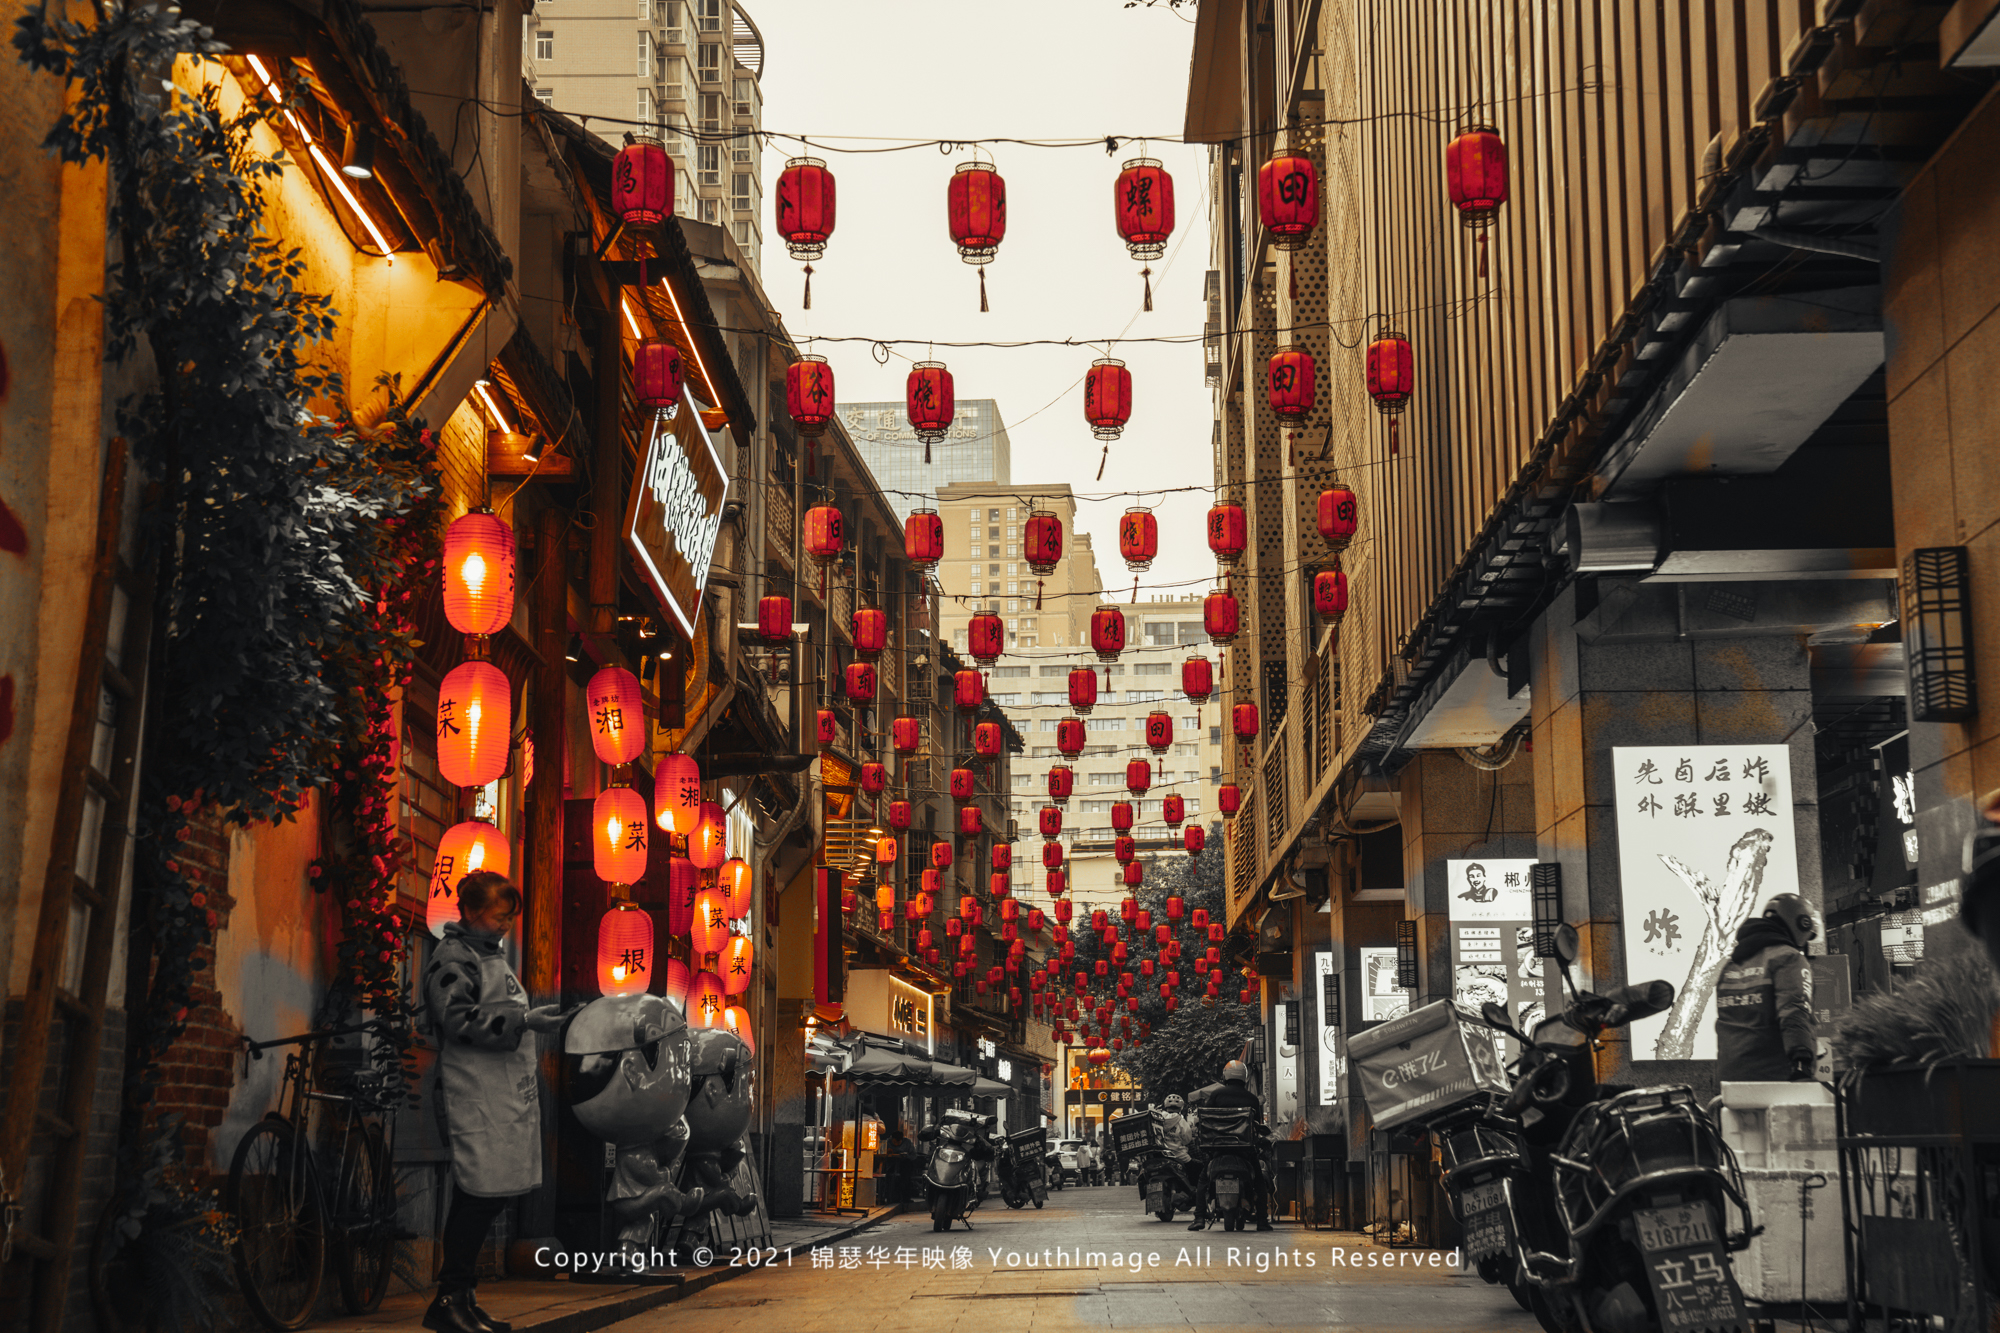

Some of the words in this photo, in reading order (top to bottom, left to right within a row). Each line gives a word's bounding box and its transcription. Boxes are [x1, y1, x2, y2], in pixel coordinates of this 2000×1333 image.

[1127, 179, 1152, 218] 螺
[1279, 171, 1309, 209] 田
[806, 372, 828, 404] 谷
[1273, 364, 1297, 393] 田
[913, 379, 937, 411] 烧
[867, 433, 880, 441] OF
[1337, 501, 1355, 524] 田
[1044, 525, 1060, 552] 谷
[1122, 521, 1139, 547] 烧
[1210, 513, 1224, 540] 螺
[1318, 582, 1334, 602] 鸭
[1104, 617, 1120, 643] 烧
[593, 694, 619, 707] 老牌坊
[438, 698, 460, 738] 菜
[596, 707, 623, 734] 湘
[1151, 721, 1165, 738] 田
[872, 768, 883, 785] 桂
[953, 774, 965, 791] 林
[1633, 756, 1770, 785] 先卤后炸
[681, 786, 699, 808] 湘
[1637, 792, 1777, 819] 外酥里嫩
[626, 822, 647, 852] 菜
[709, 907, 727, 929] 菜
[1643, 907, 1682, 949] 炸
[620, 949, 646, 976] 根
[730, 956, 747, 975] 菜
[700, 994, 721, 1014] 根
[1819, 1066, 1830, 1074] 40
[1465, 1191, 1503, 1214] 0671081
[1655, 1211, 1691, 1227] 长沙
[1643, 1222, 1711, 1248] 3187211
[1654, 1252, 1725, 1290] 立马
